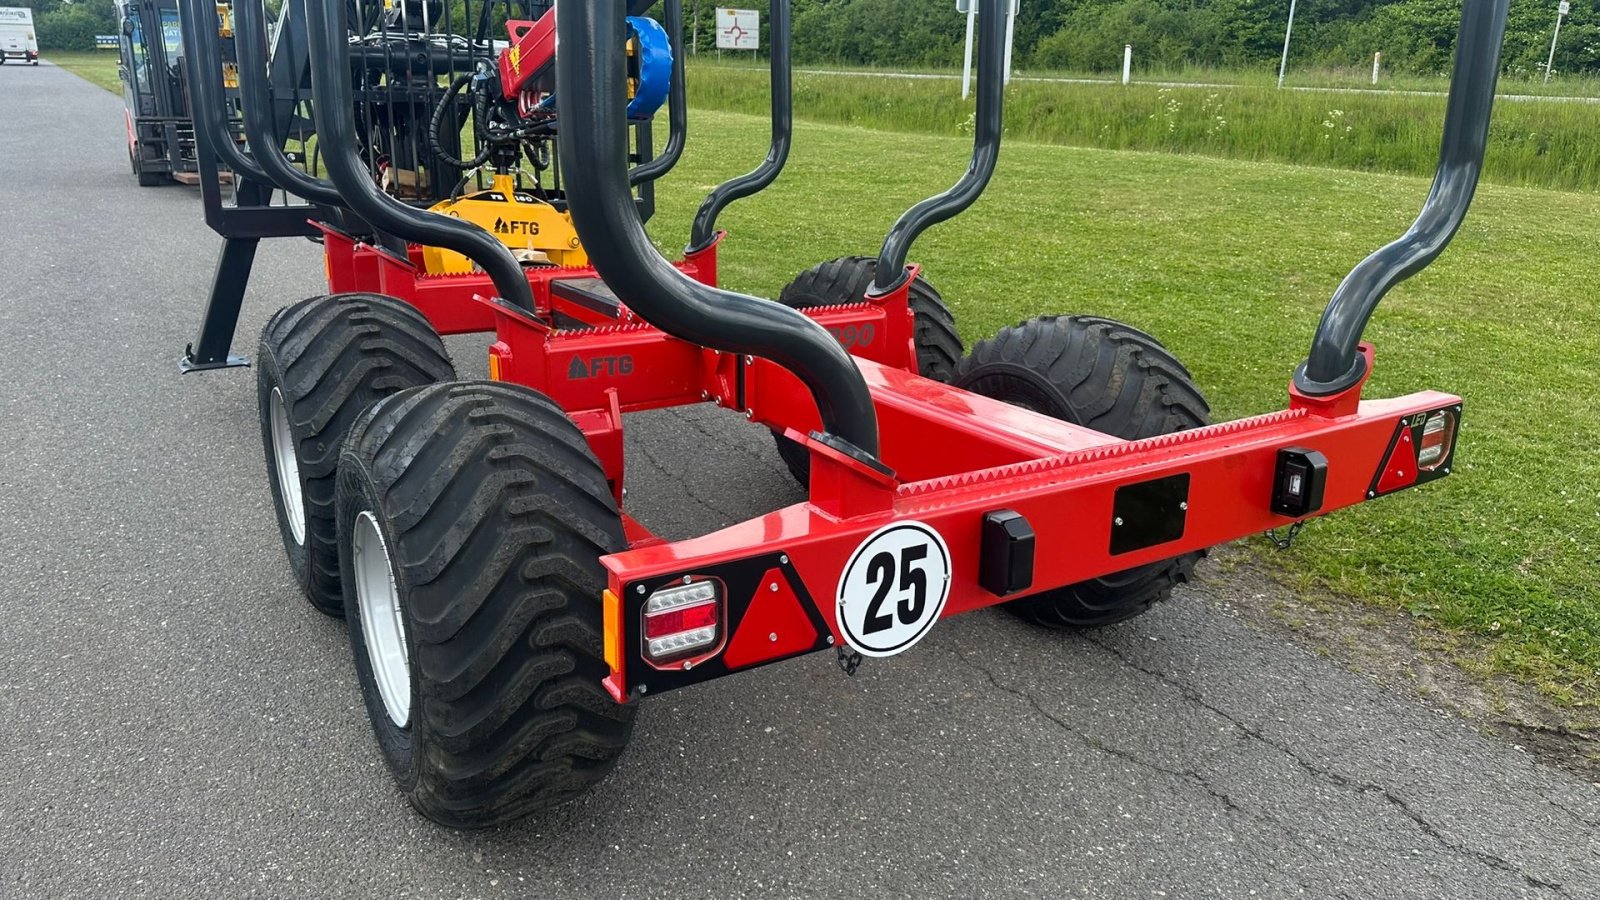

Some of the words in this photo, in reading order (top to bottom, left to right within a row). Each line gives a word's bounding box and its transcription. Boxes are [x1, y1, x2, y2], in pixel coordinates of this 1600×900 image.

[510, 220, 540, 236] FTG
[591, 355, 633, 377] FTG
[1411, 412, 1427, 428] LED
[862, 543, 928, 636] 25
